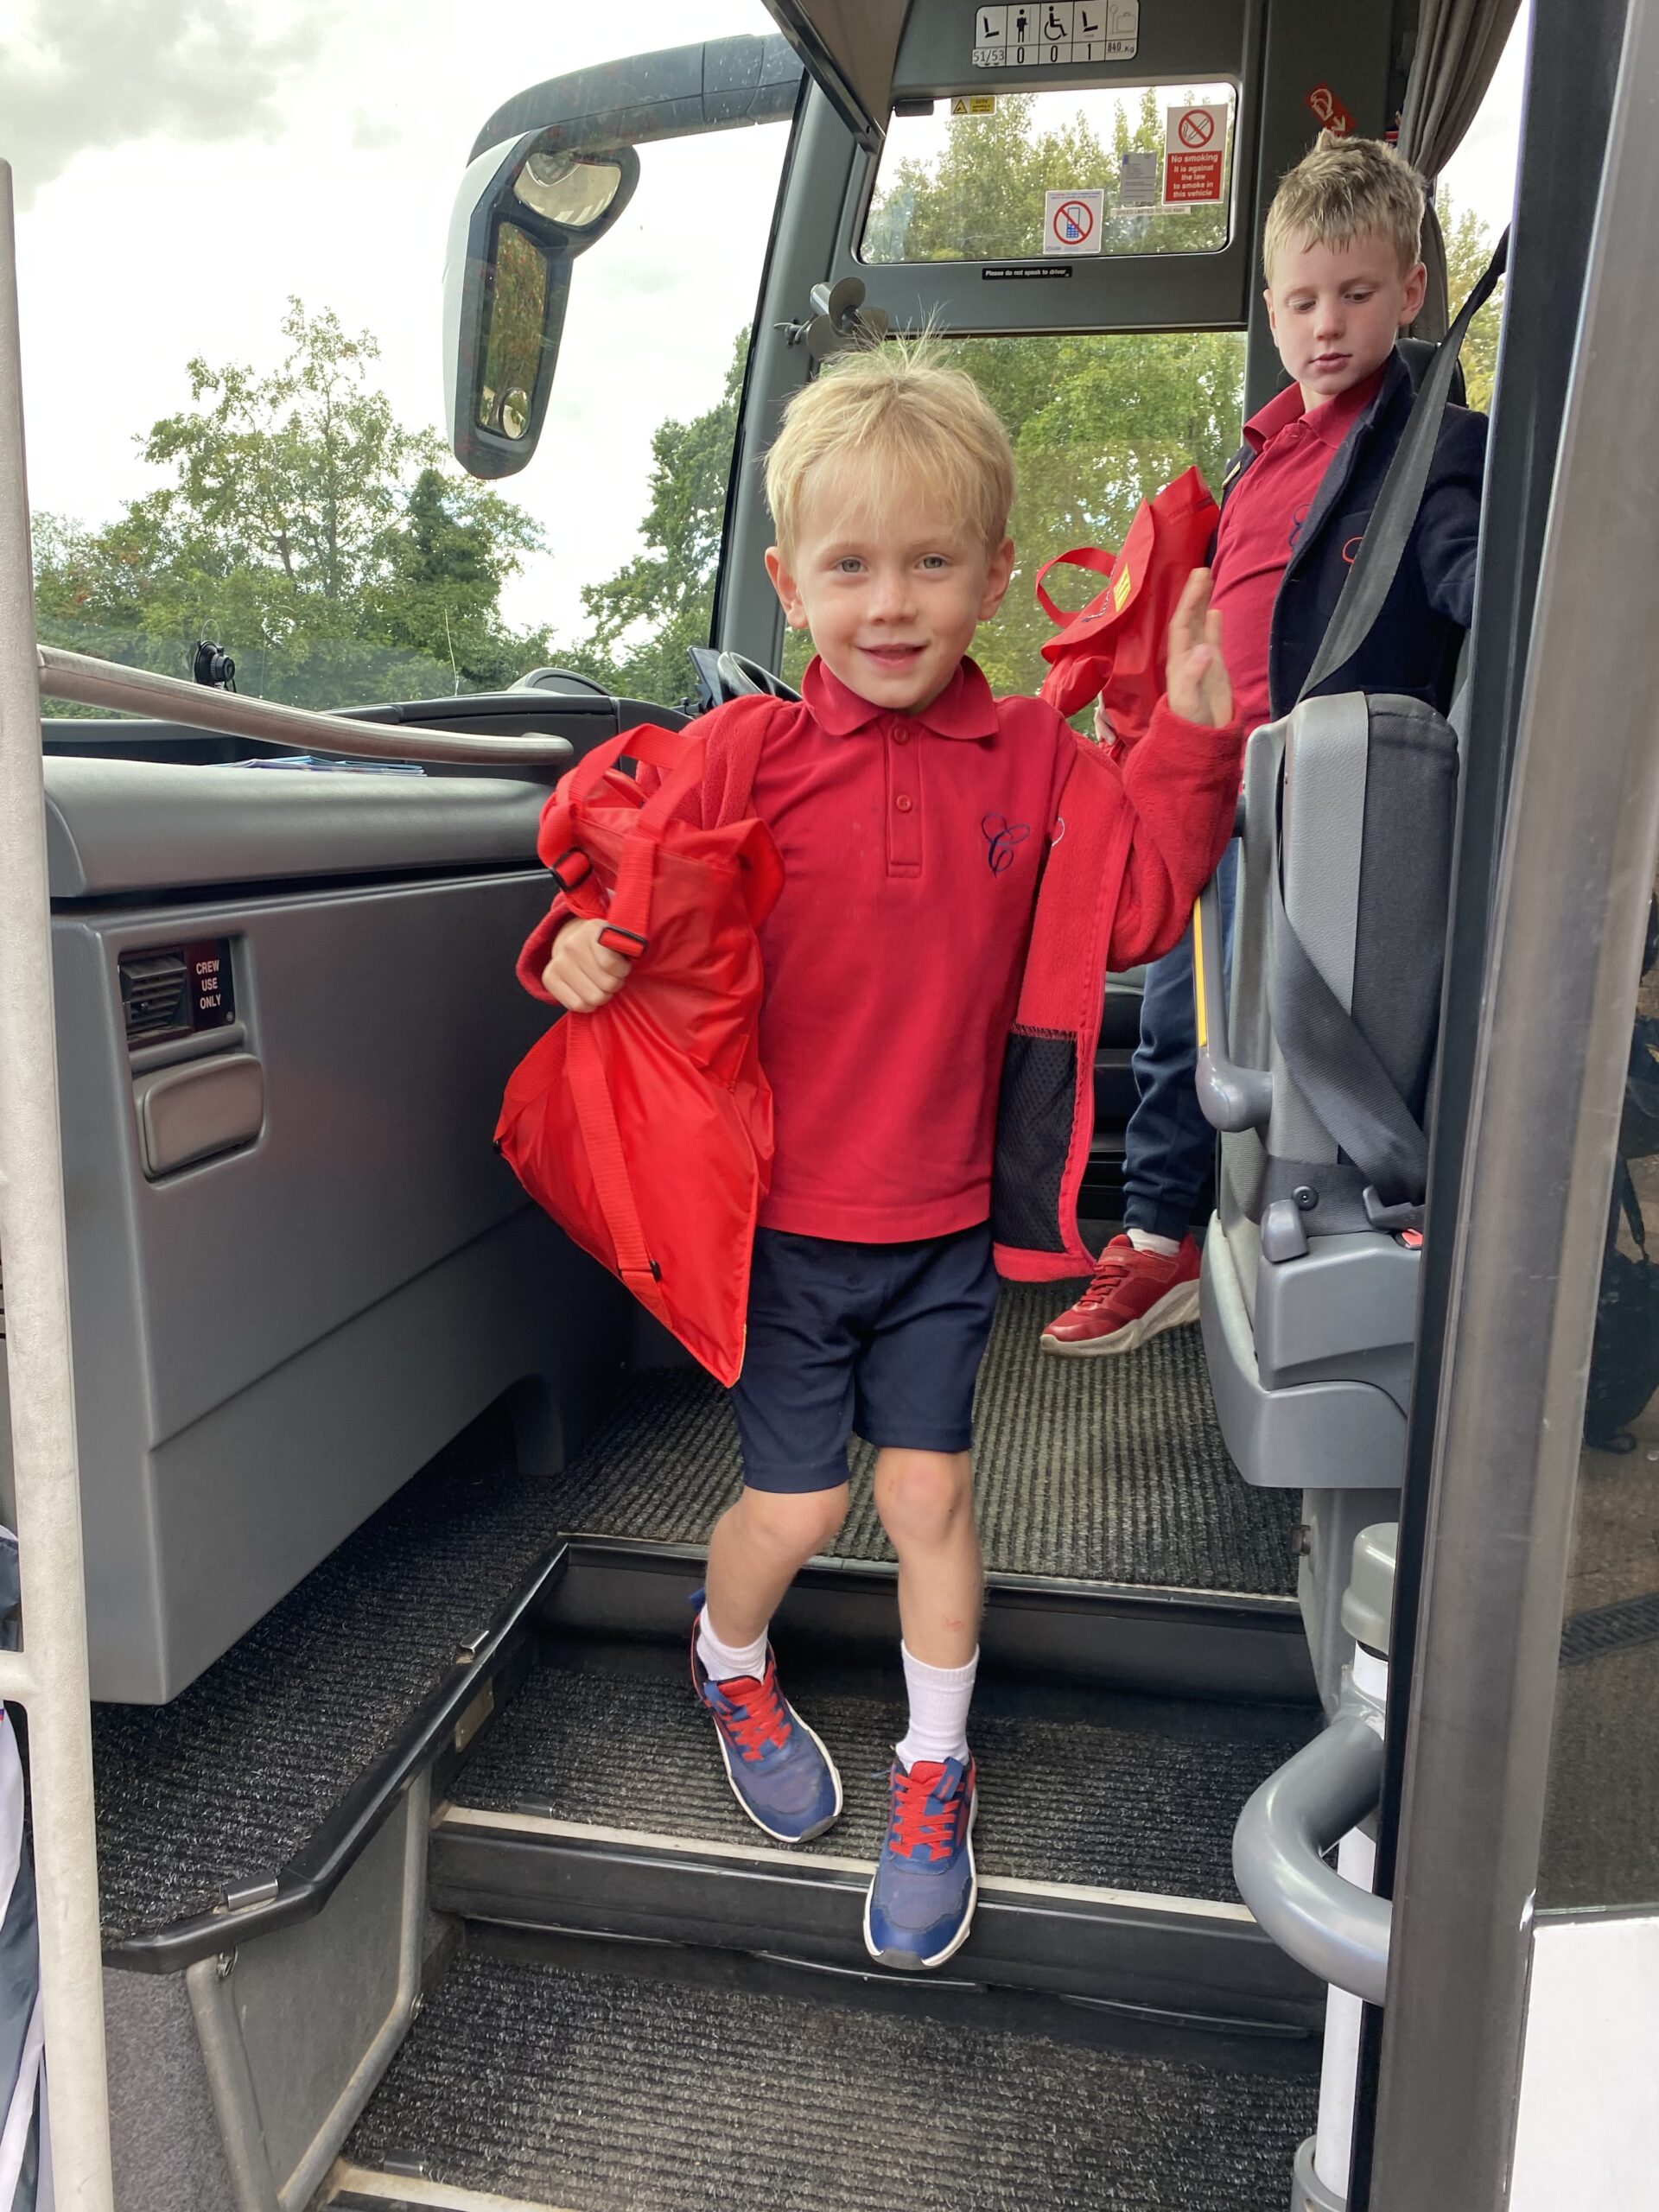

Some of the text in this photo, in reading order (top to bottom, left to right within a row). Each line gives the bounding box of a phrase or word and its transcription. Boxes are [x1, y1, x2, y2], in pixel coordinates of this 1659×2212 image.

[973, 49, 1004, 62] 51/53
[1017, 47, 1025, 64] 0
[1050, 45, 1058, 62] 0
[1171, 153, 1218, 163] No smoking
[1188, 164, 1214, 174] against
[195, 959, 219, 975] CREW
[201, 977, 218, 991] USE
[200, 994, 221, 1010] ONLY
